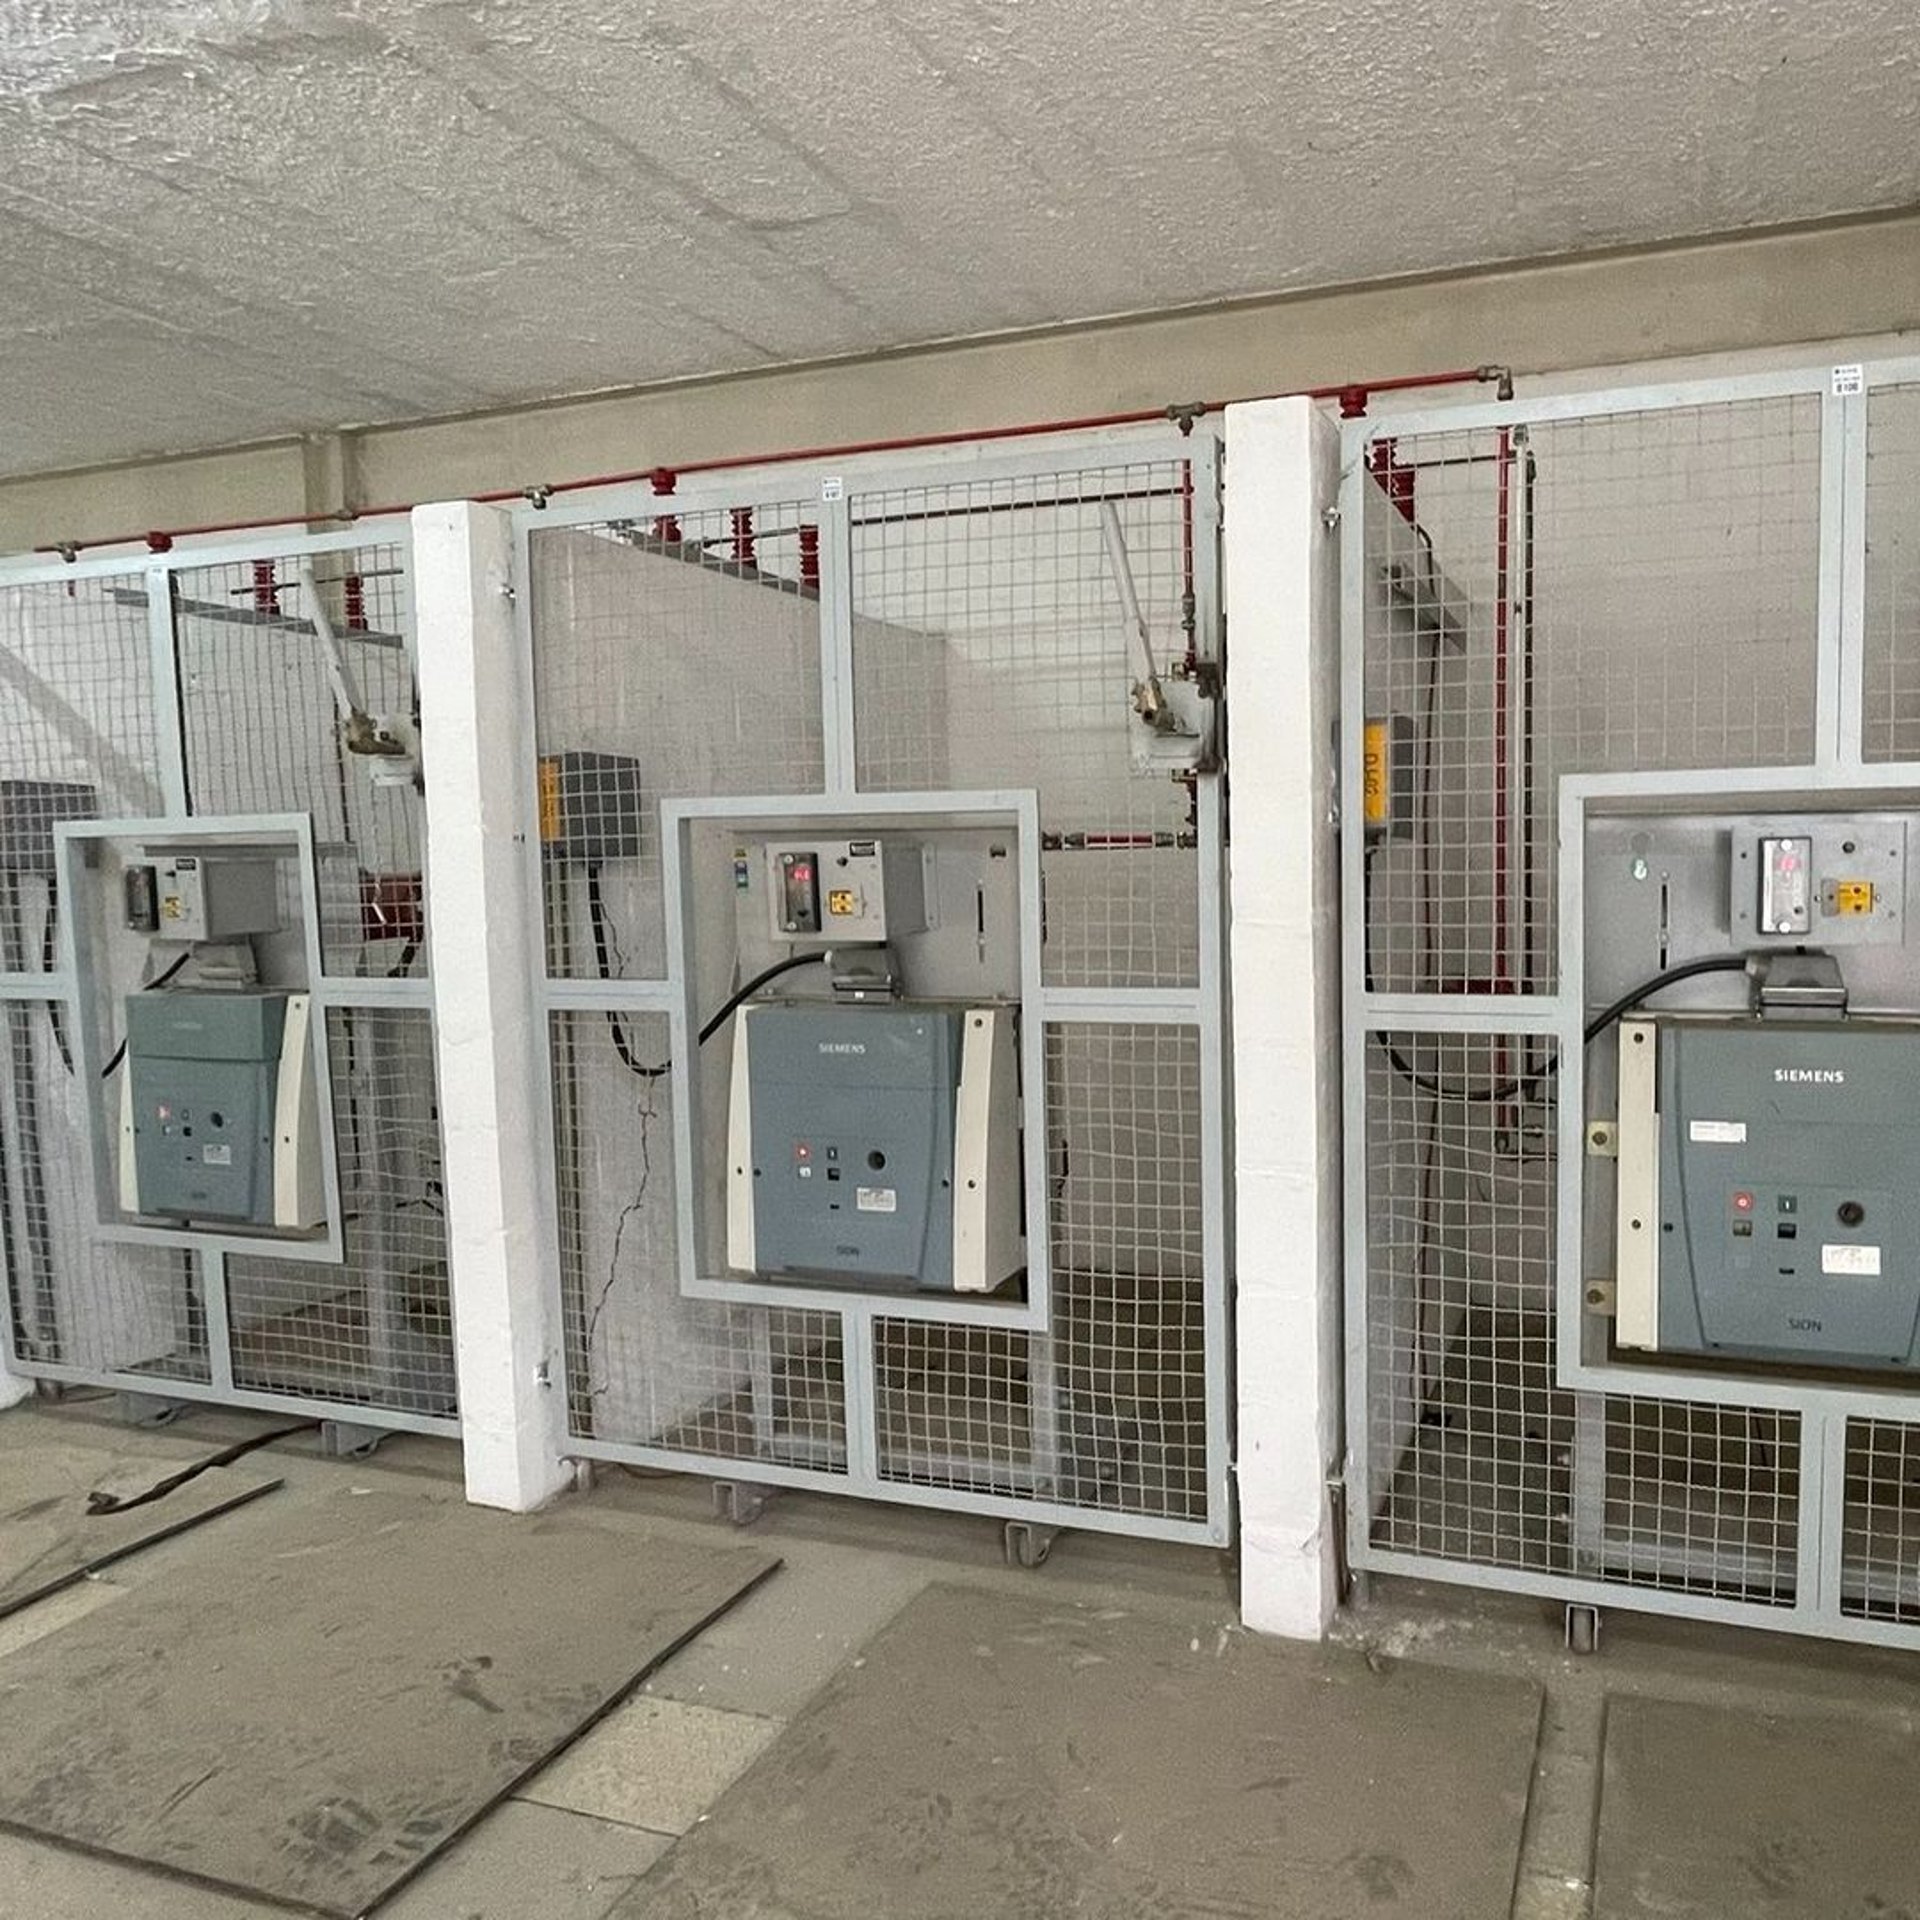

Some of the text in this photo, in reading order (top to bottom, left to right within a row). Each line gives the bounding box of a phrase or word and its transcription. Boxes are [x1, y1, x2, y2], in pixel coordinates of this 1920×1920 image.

[819, 1044, 866, 1055] SIEMENS
[1773, 1068, 1845, 1083] SIEMENS
[1788, 1318, 1822, 1332] SION
